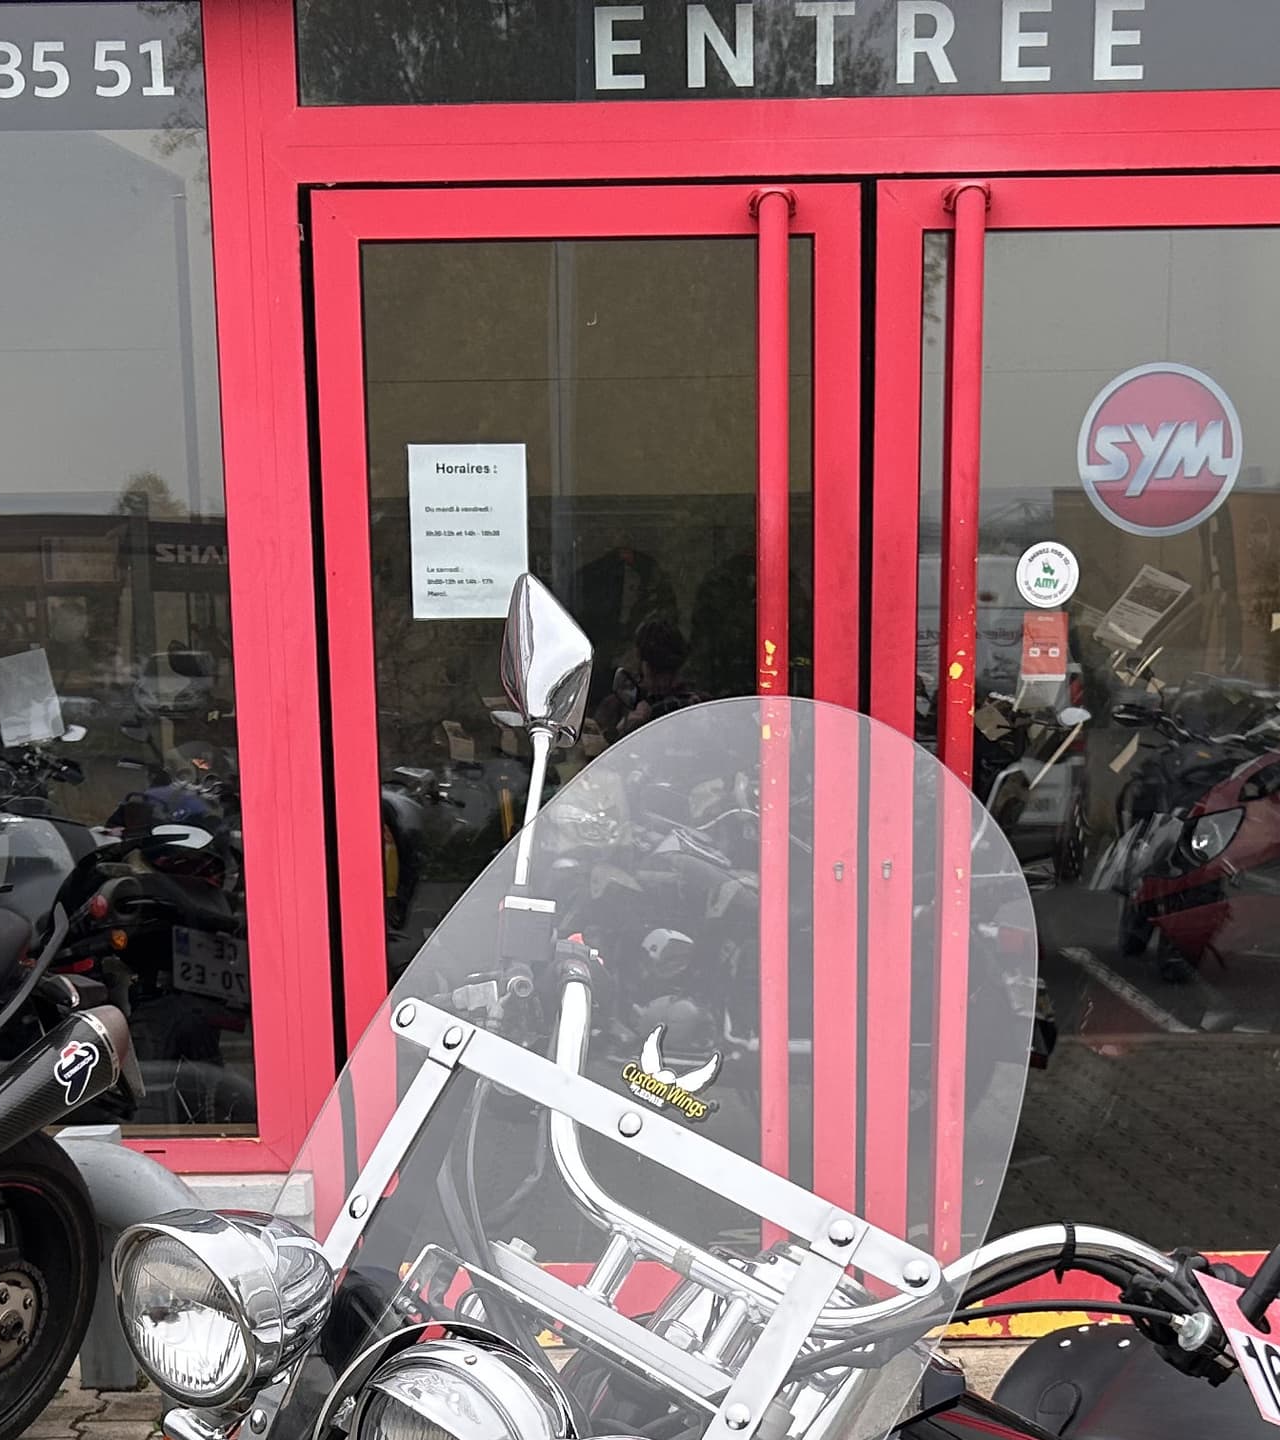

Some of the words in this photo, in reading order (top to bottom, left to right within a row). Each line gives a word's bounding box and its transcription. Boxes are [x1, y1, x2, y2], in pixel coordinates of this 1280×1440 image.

[94, 39, 176, 97] 51
[595, 0, 1146, 90] ENTREE
[436, 463, 491, 474] Horaires
[1082, 420, 1233, 498] SYM
[155, 544, 228, 564] SHA
[622, 1062, 667, 1098] Custom
[666, 1083, 707, 1118] Wings
